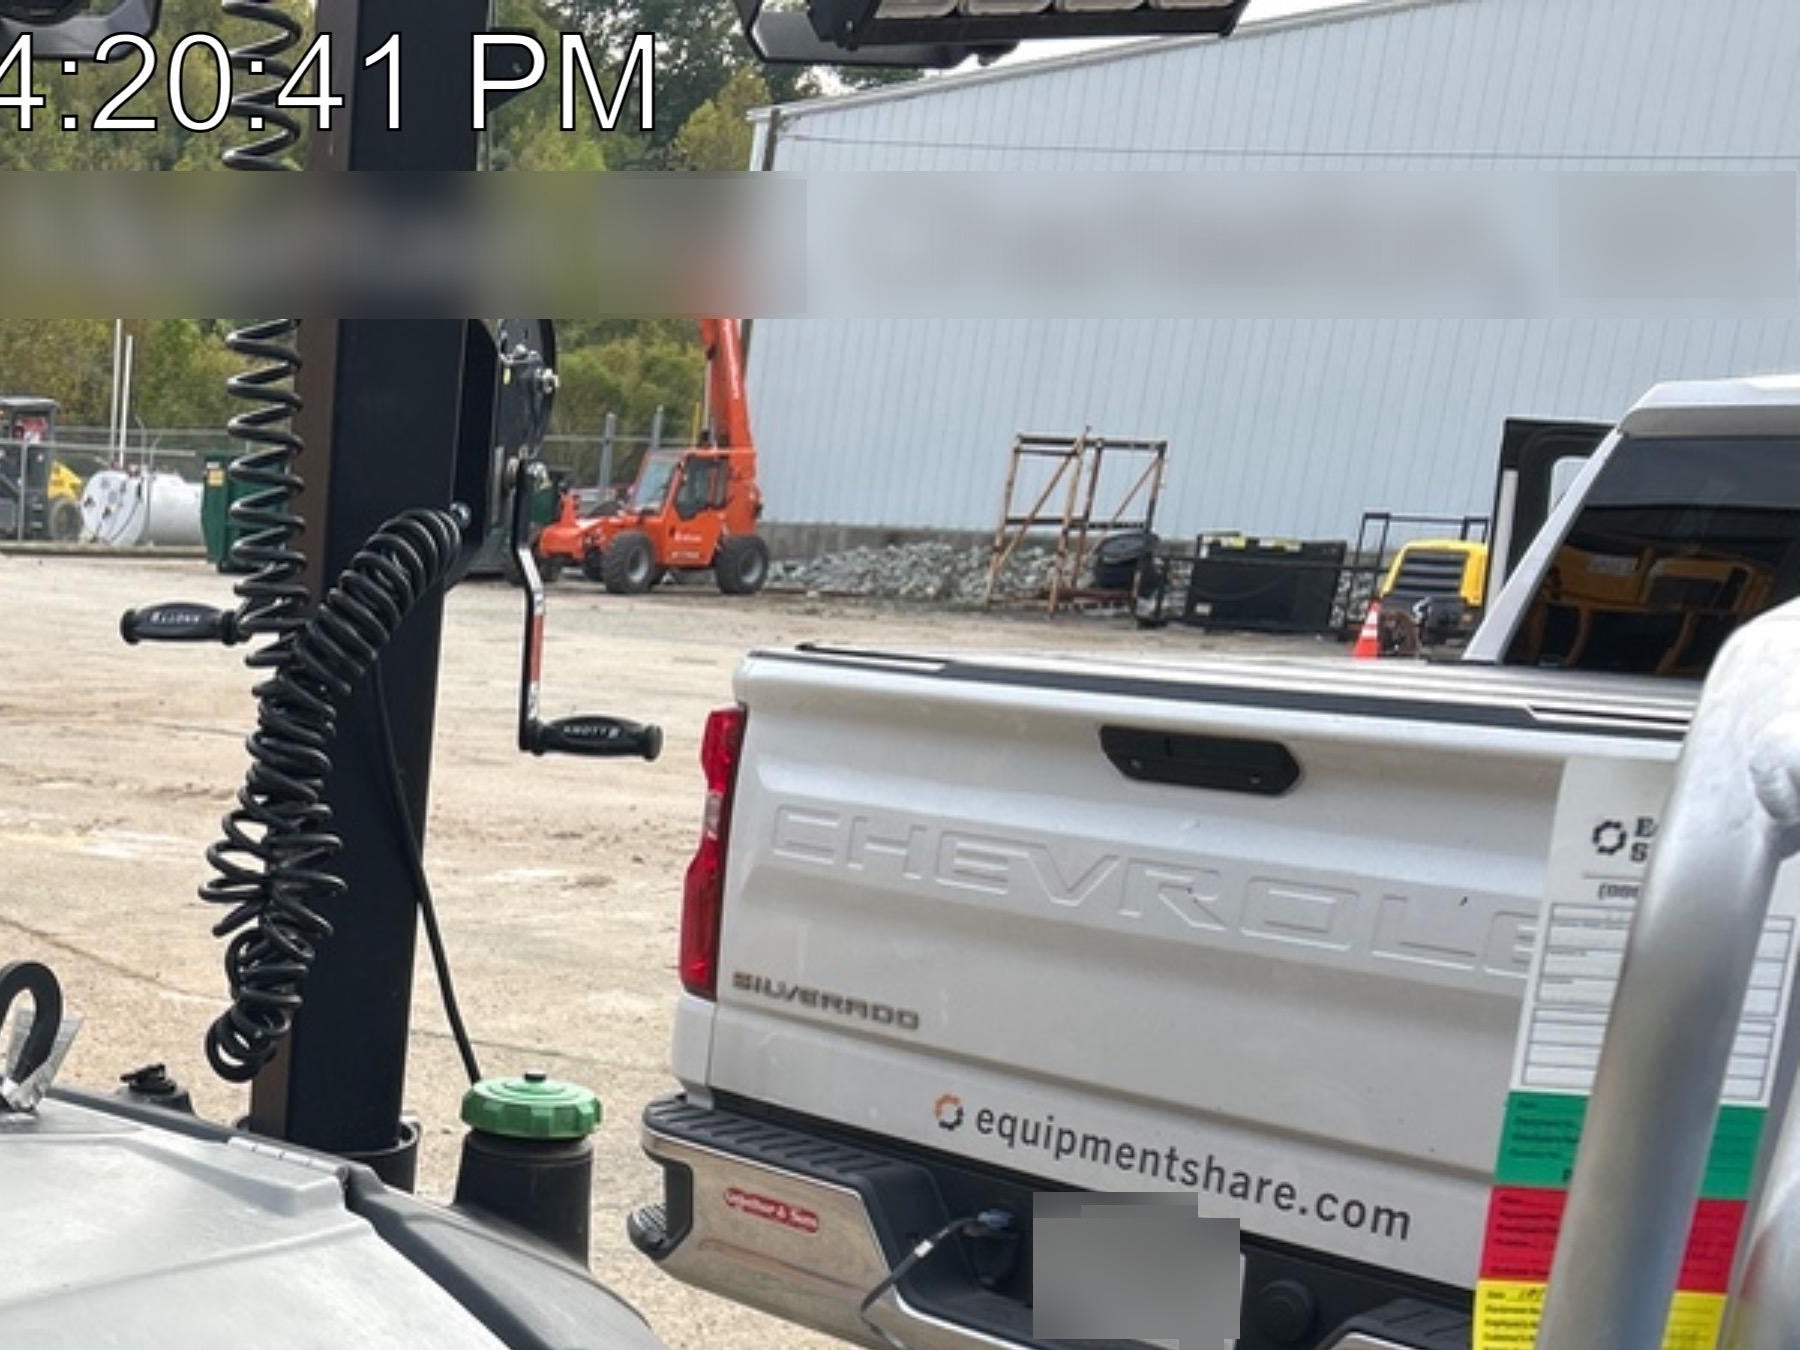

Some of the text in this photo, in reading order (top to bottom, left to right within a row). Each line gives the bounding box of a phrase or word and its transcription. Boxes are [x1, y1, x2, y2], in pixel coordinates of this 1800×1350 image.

[772, 804, 1538, 979] CHEVROLE
[732, 970, 921, 1032] SILVERADO
[975, 1105, 1413, 1242] equipmentshare.com
